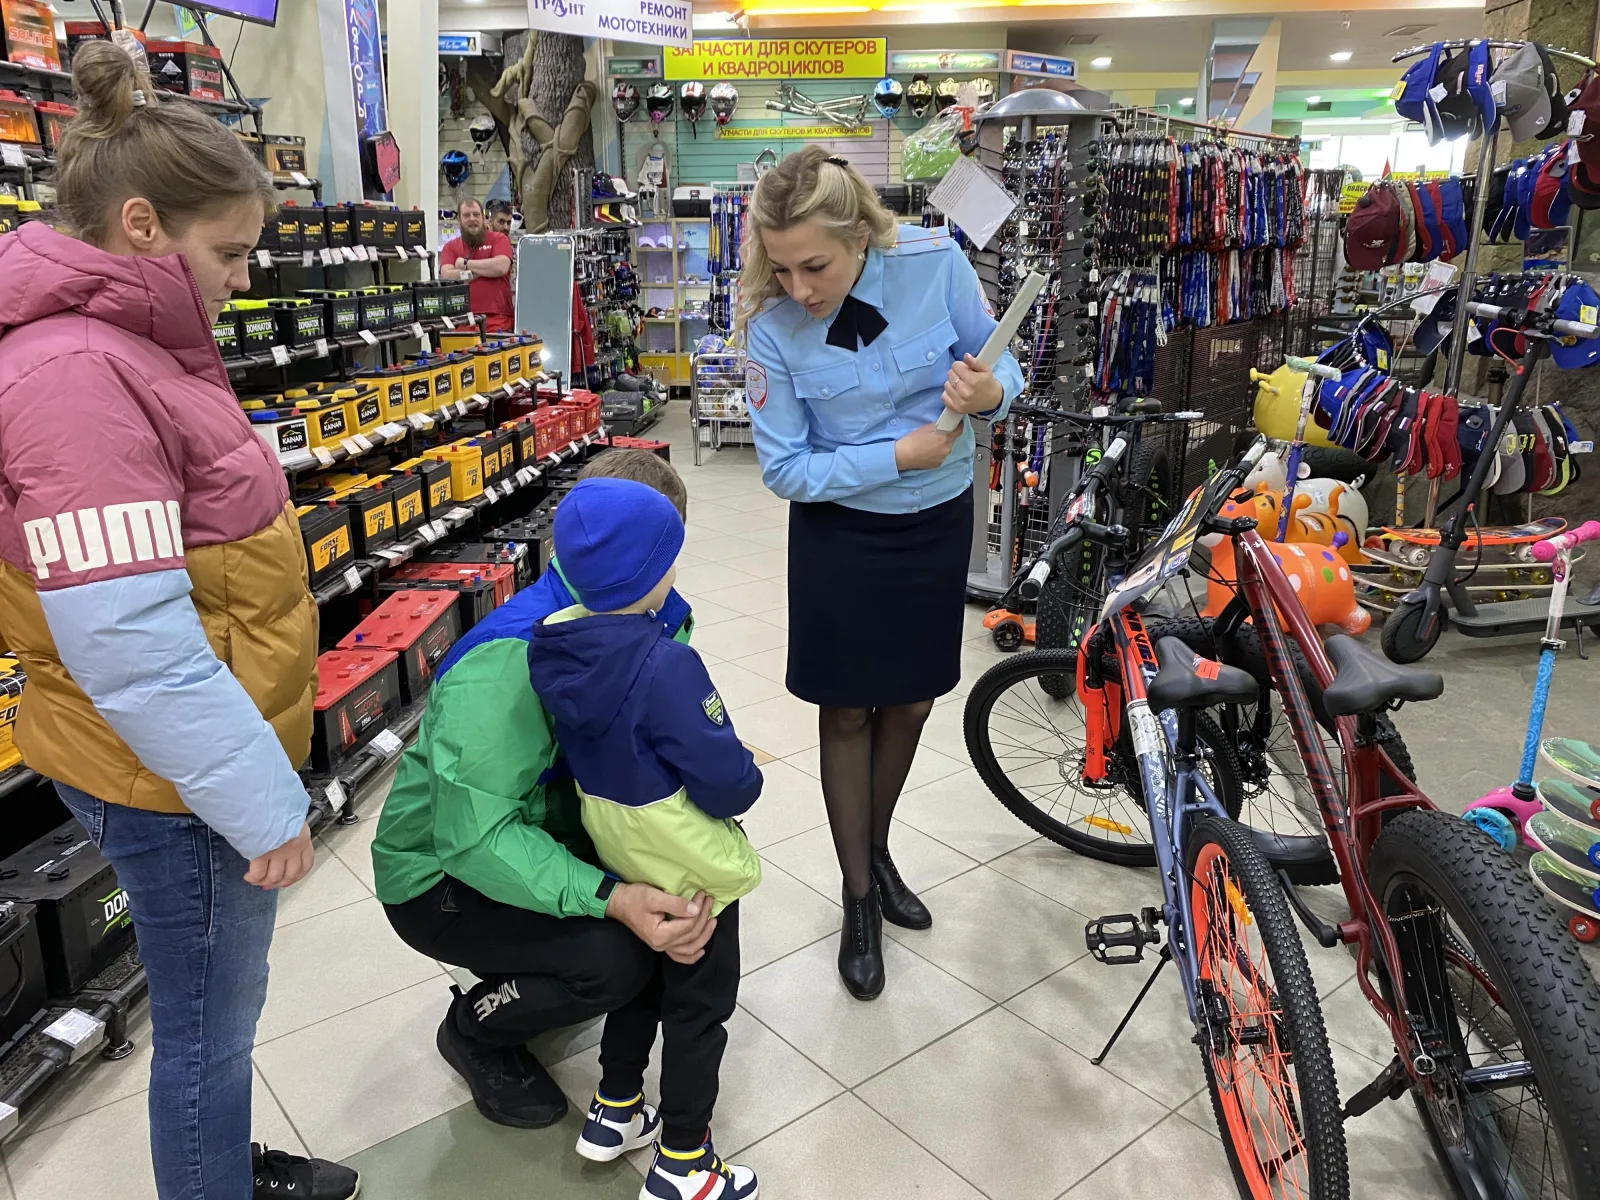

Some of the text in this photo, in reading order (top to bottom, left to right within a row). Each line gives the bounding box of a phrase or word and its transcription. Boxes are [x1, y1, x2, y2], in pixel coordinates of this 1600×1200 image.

[640, 1, 687, 20] РЕМОНТ
[598, 15, 687, 39] МОТОТЕХНИКИ
[672, 40, 877, 57] ЗАПЧАСТИ ДЛЯ СКУТЕРОВ
[703, 60, 844, 77] И КВАДРОЦИКЛОВ
[718, 128, 751, 136] АПЧАСТИ
[246, 321, 272, 334] DOMINATOR
[298, 319, 319, 331] DOMINATOR
[323, 420, 342, 432] KAINAR
[282, 434, 303, 445] KAINAR
[369, 509, 387, 521] FORSE
[320, 535, 339, 552] FORSE
[473, 979, 521, 1022] NIKE
